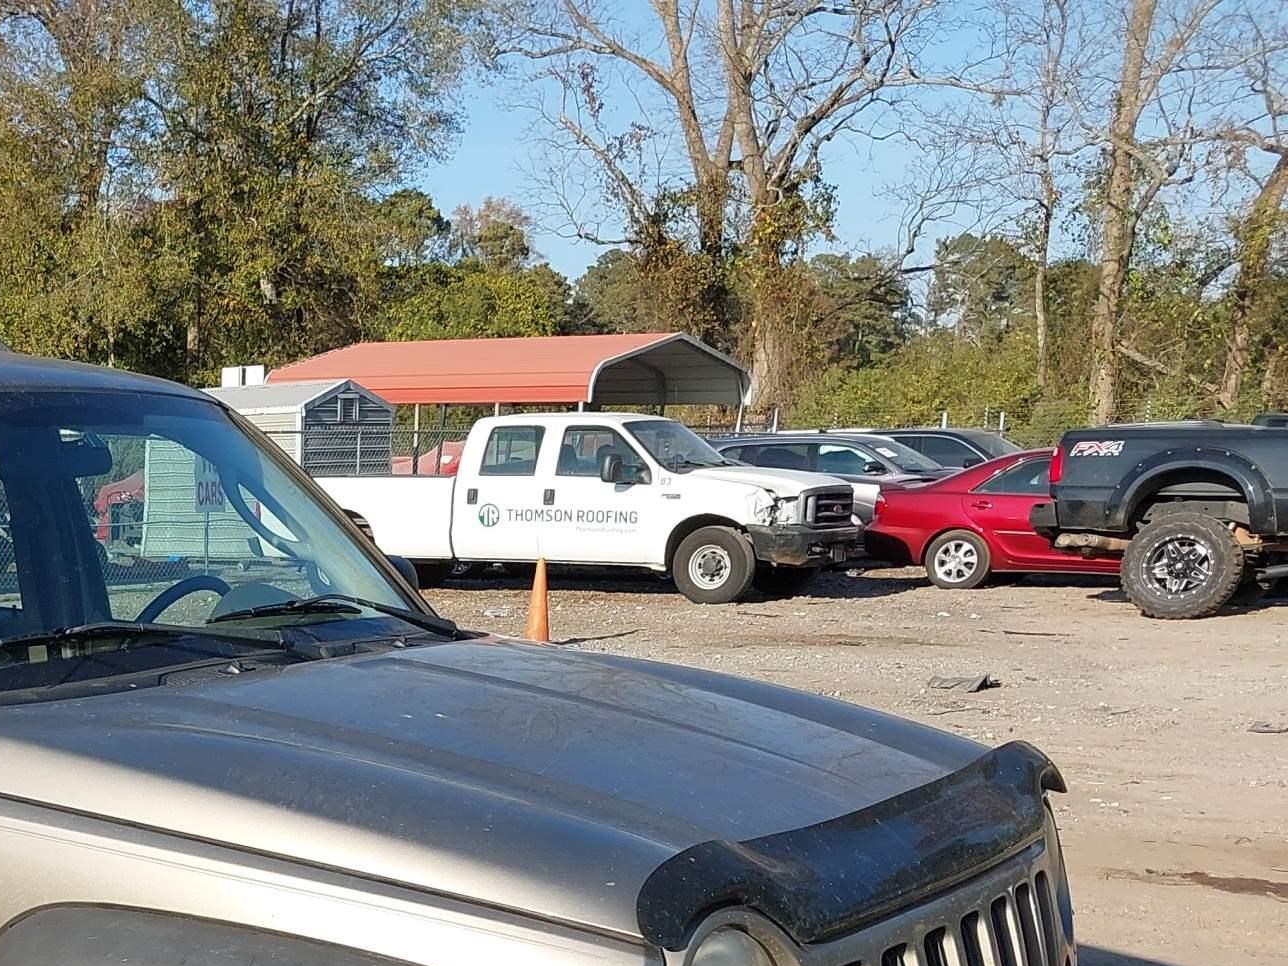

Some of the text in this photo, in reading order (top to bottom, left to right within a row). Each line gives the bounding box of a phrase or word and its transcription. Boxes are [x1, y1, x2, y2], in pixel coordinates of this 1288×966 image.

[1070, 440, 1125, 453] FX4
[198, 480, 224, 506] CARS
[506, 508, 638, 524] THOMSON ROOFING
